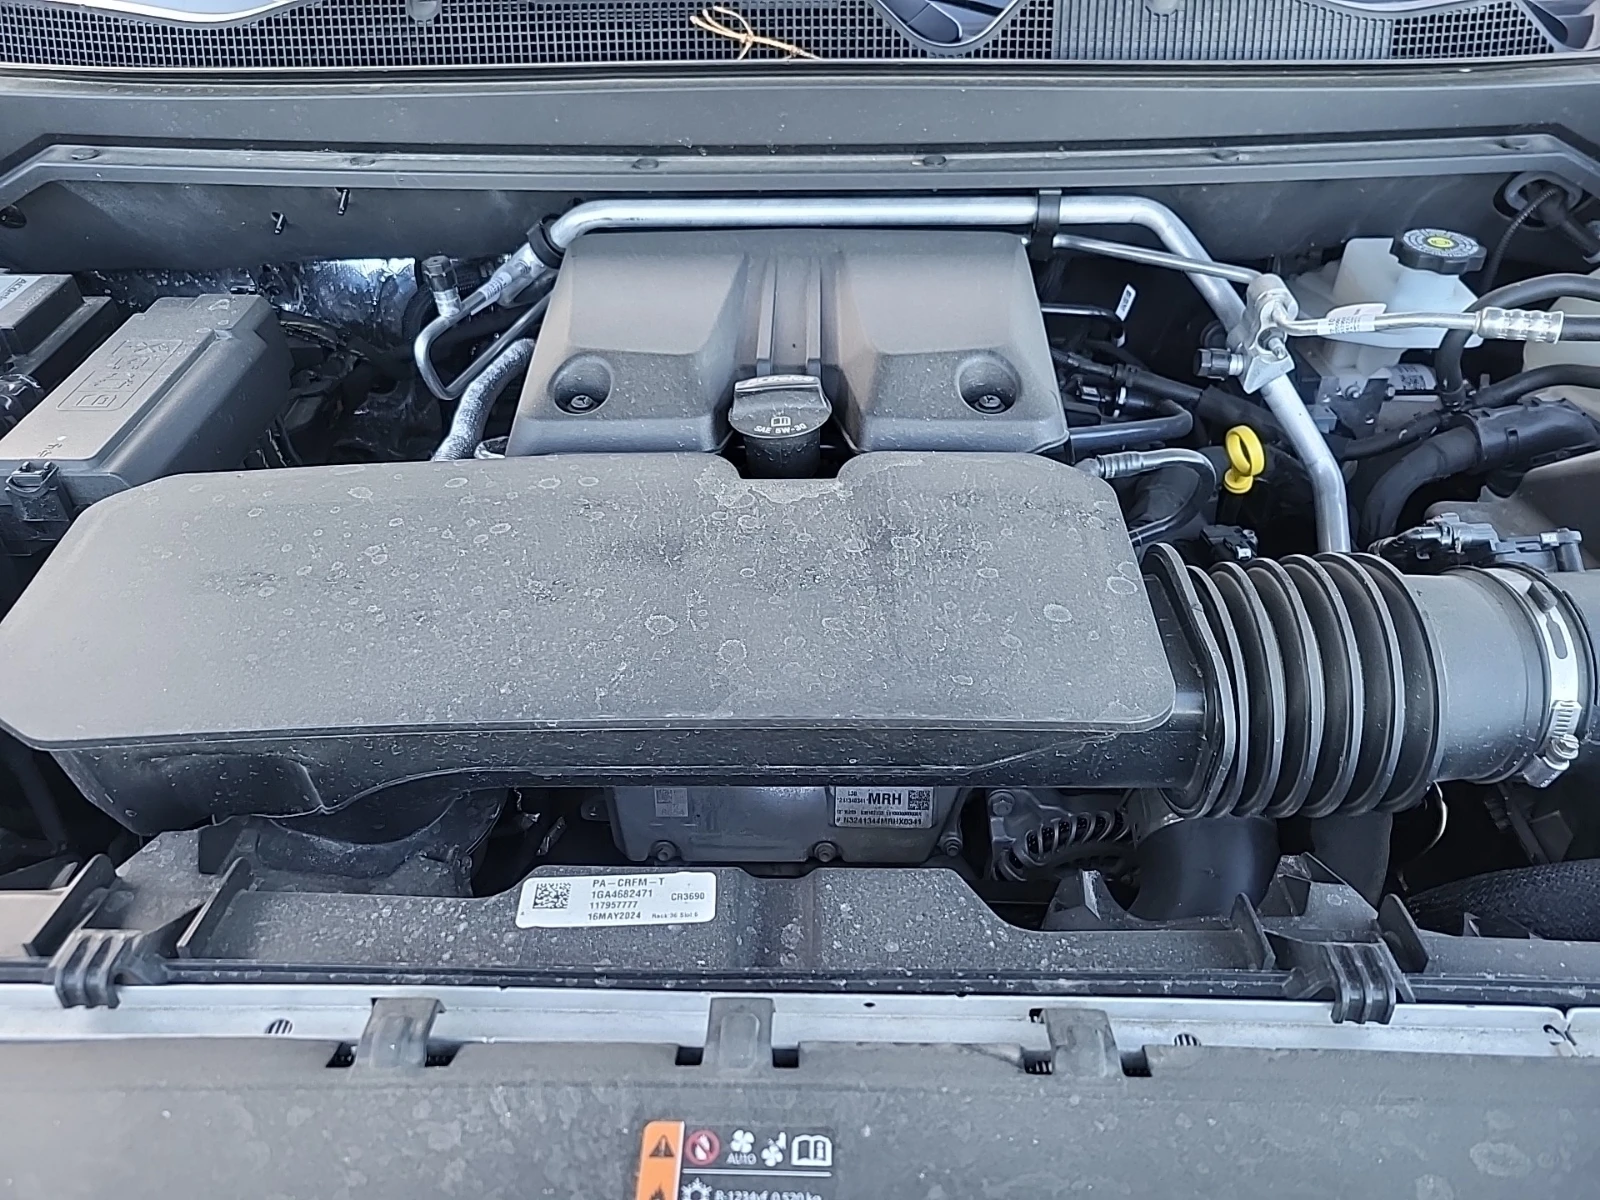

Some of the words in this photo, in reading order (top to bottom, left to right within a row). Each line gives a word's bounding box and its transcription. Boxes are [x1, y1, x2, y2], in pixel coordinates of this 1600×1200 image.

[0, 278, 27, 301] ACDel
[754, 425, 771, 433] SAE
[775, 423, 807, 434] 5W-30
[867, 792, 902, 805] MRH
[592, 877, 665, 888] PA-CRFM-T
[591, 889, 653, 899] 1GA4682471
[589, 901, 638, 909] 117957777
[588, 911, 641, 920] 16MAY2024
[726, 1153, 757, 1165] AUTO
